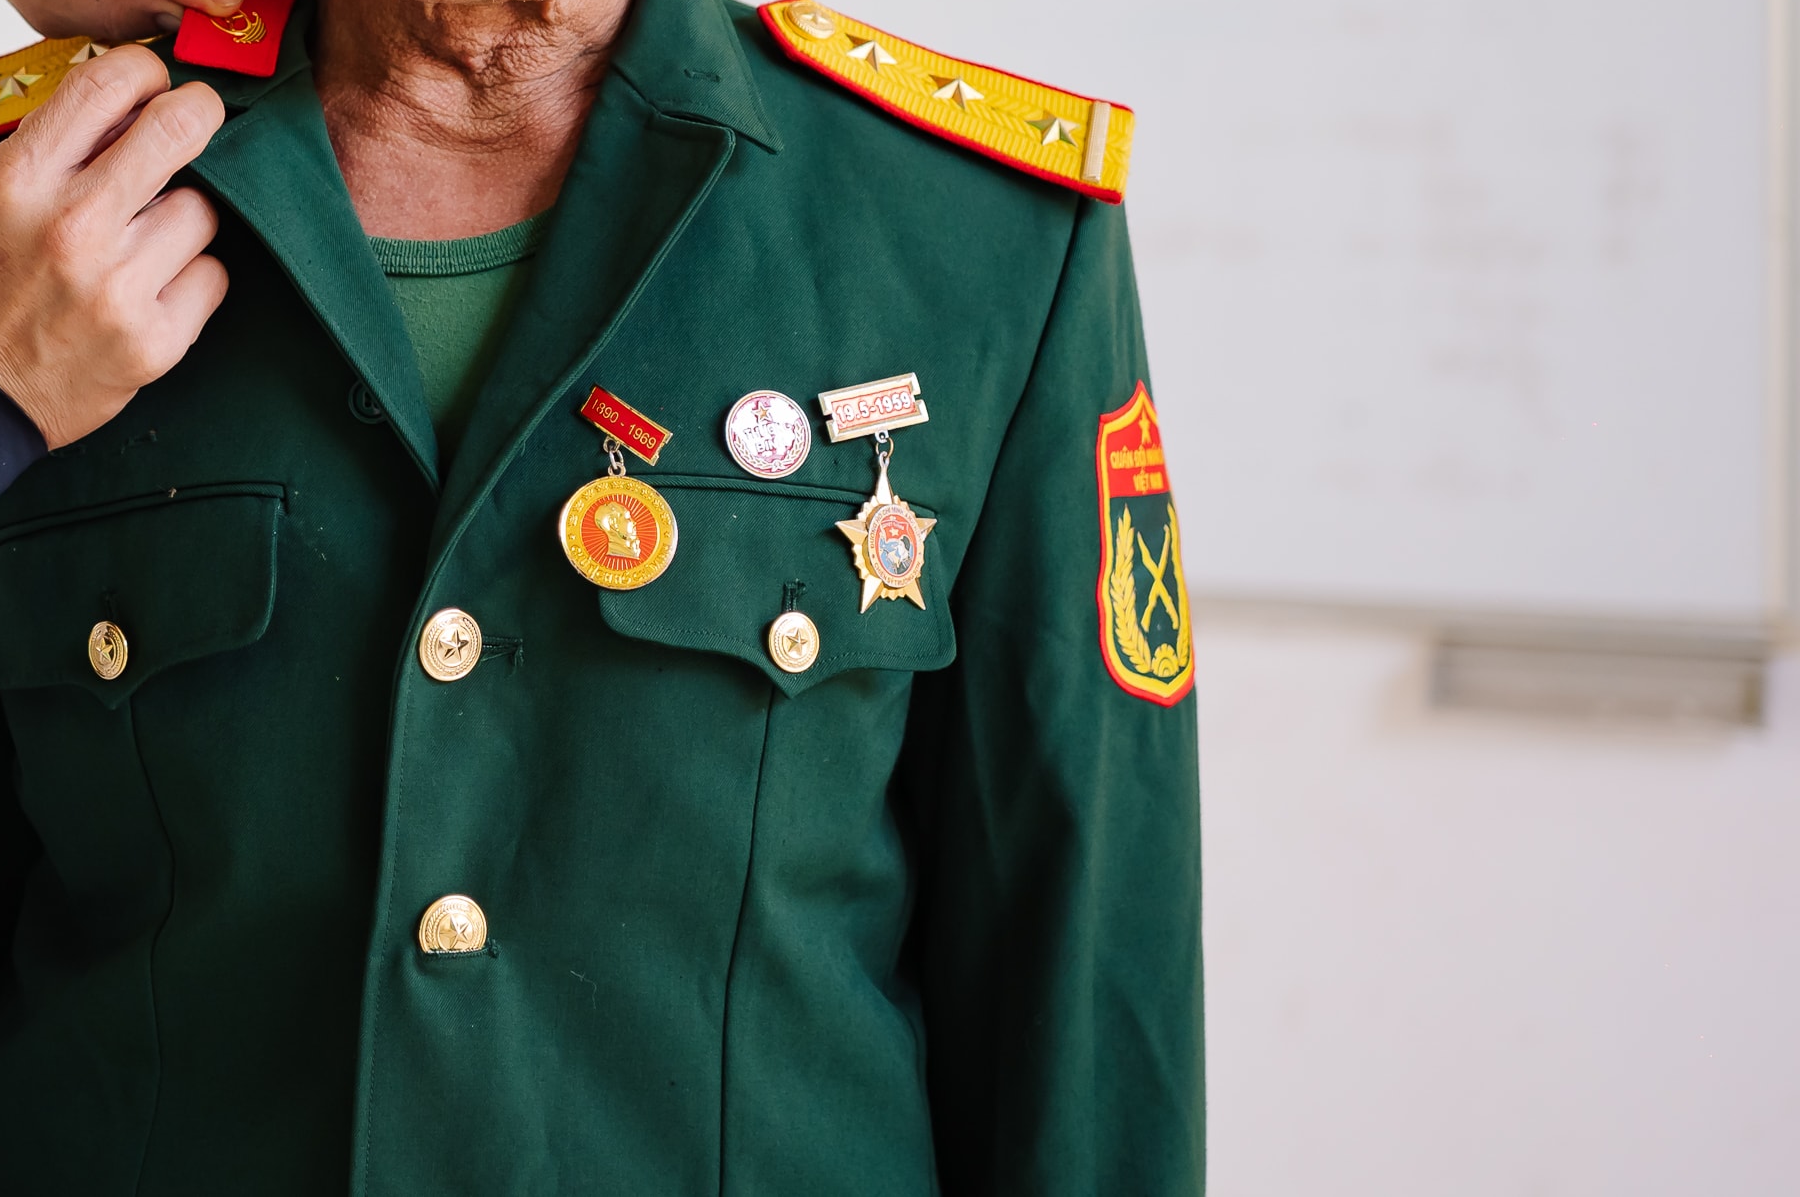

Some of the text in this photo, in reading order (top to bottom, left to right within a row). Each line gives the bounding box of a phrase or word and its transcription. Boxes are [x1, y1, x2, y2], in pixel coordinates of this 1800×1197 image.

[591, 398, 619, 424] 1890
[628, 423, 657, 449] 1969
[835, 390, 912, 424] 19.5-1959
[1110, 445, 1134, 469] QUÂN
